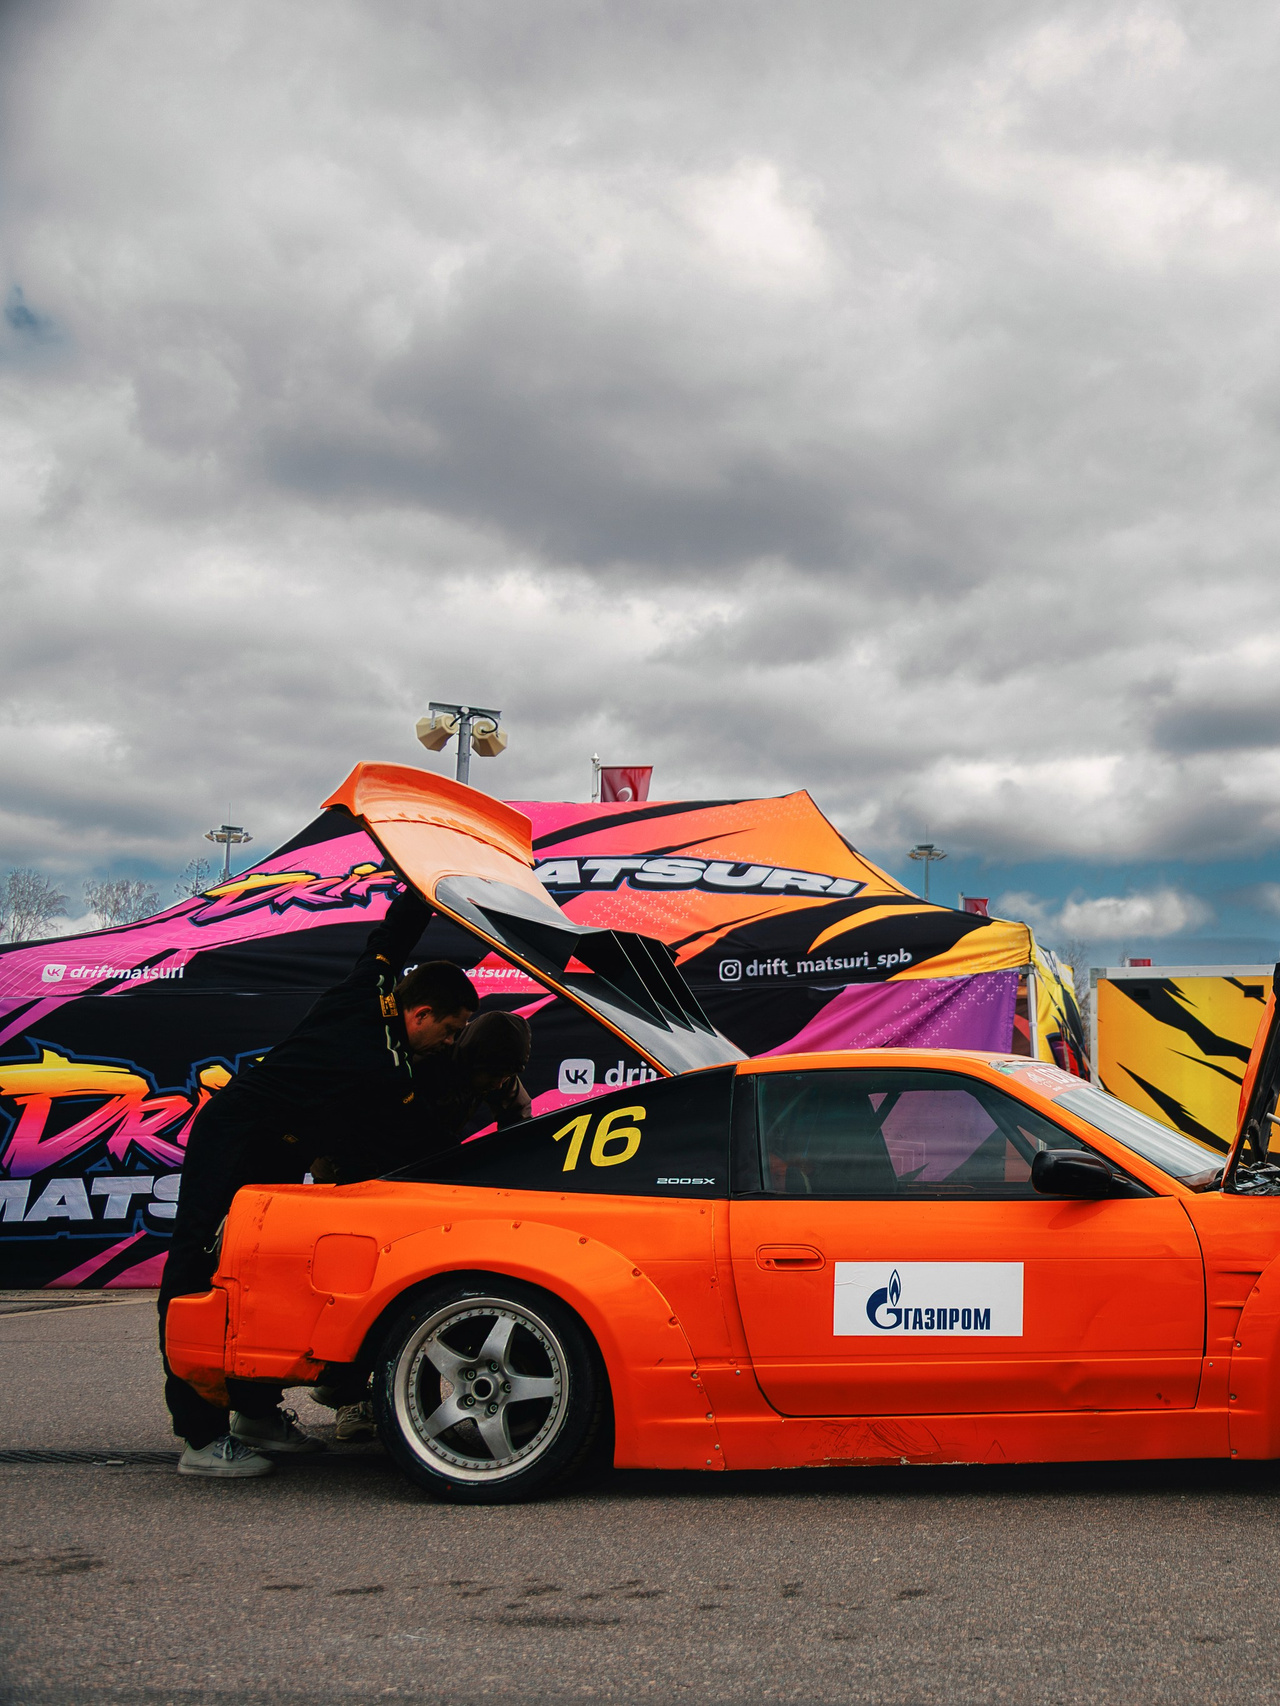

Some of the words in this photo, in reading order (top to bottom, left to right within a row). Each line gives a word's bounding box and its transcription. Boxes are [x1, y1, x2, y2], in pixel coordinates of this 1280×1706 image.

[536, 859, 859, 895] ATSURI
[70, 962, 185, 979] driftmatsuri
[746, 948, 913, 977] drift_matsuri_spb
[552, 1105, 647, 1172] 16
[656, 1177, 716, 1185] 200SX
[903, 1307, 991, 1331] ГАЗПРОМ
